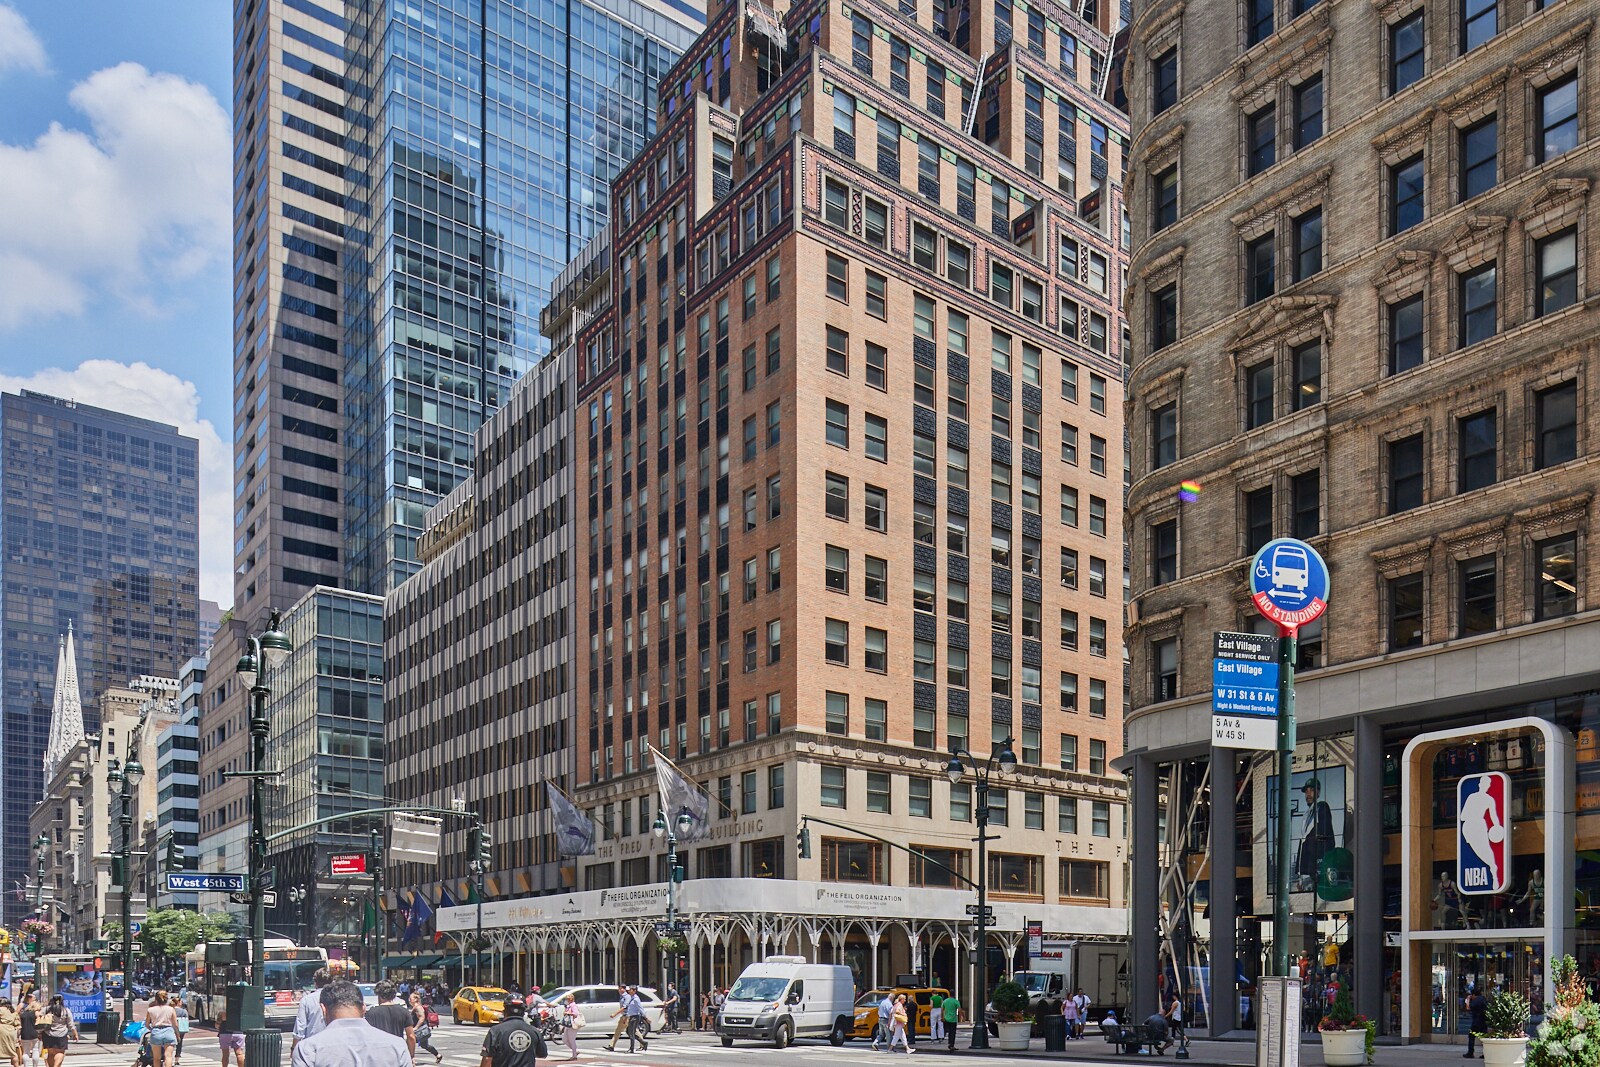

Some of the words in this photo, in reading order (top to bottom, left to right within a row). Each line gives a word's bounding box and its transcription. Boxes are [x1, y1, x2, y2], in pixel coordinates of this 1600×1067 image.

[1258, 596, 1272, 611] NO
[1272, 601, 1321, 622] STANDING
[1218, 640, 1234, 650] East
[1236, 640, 1261, 652] Village
[1218, 662, 1234, 673] East
[1236, 664, 1262, 676] Village
[1218, 689, 1226, 699] W
[1228, 690, 1236, 699] 31
[1240, 690, 1248, 700] St
[1250, 692, 1256, 701] &
[1258, 692, 1263, 702] 6
[1265, 692, 1274, 702] Av
[1266, 706, 1276, 714] Only
[1216, 718, 1220, 727] 5
[1223, 719, 1232, 728] Av
[1235, 720, 1240, 728] &
[1216, 730, 1224, 738] W
[1226, 730, 1235, 740] 45
[1237, 730, 1245, 740] St
[710, 819, 764, 840] BUILDING
[598, 846, 613, 858] THE
[620, 840, 642, 854] FRED
[1056, 840, 1094, 855] THE
[170, 877, 200, 888] West
[202, 877, 226, 888] 45th
[229, 878, 242, 888] St
[1464, 867, 1488, 887] NBA
[608, 894, 617, 902] THE
[618, 892, 629, 901] FEIL
[856, 894, 902, 902] ORGANIZATION
[517, 1037, 523, 1045] T
